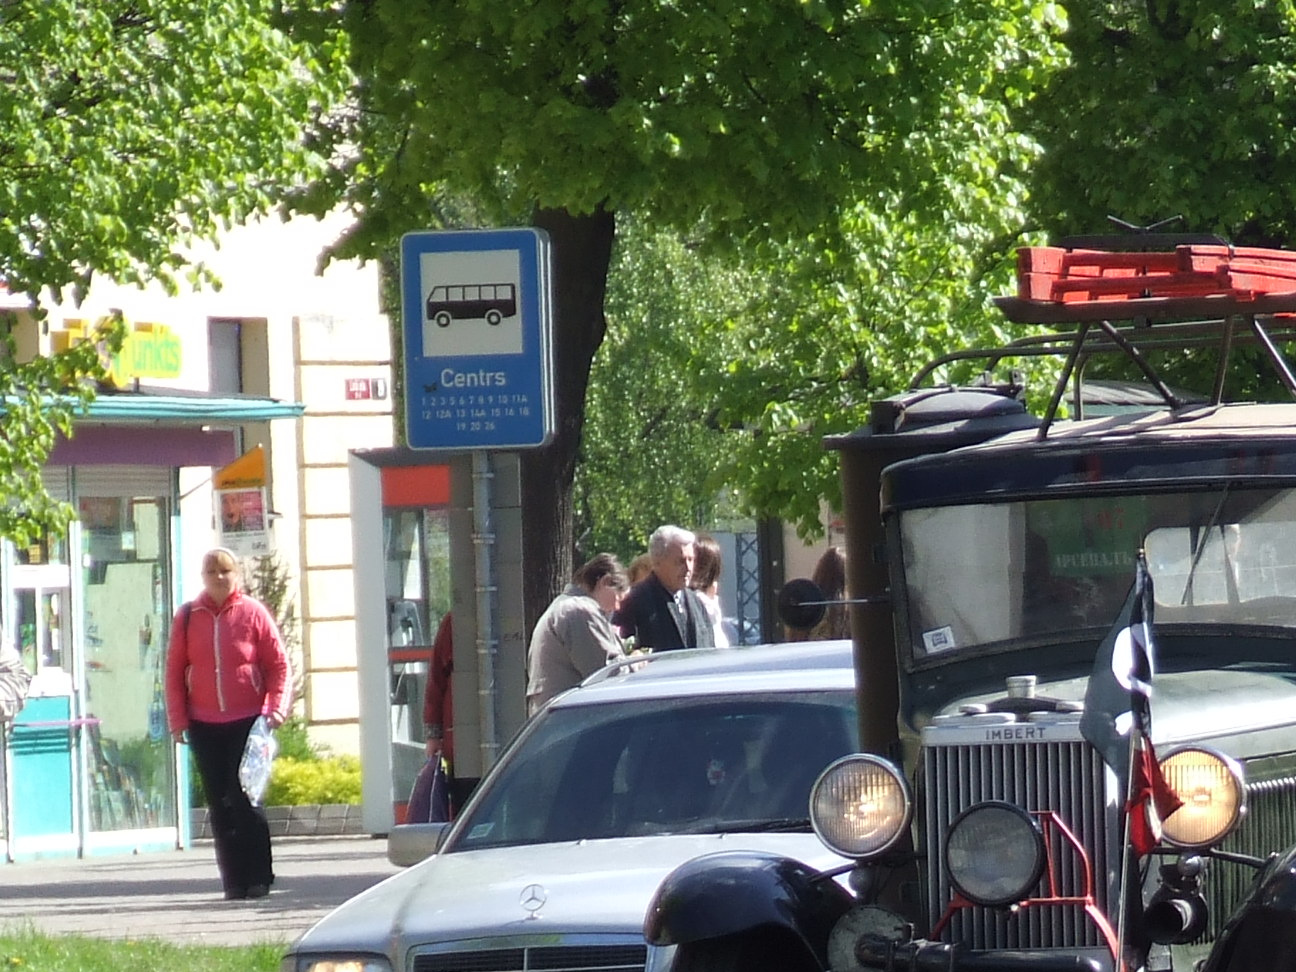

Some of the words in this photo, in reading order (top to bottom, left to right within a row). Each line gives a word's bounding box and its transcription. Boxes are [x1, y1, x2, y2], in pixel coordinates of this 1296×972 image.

[440, 368, 506, 388] Centrs
[422, 397, 426, 406] 1
[431, 397, 436, 406] 2
[440, 397, 446, 406] 3
[449, 396, 455, 406] 5
[459, 396, 465, 405] 6
[469, 396, 474, 405] 7
[478, 396, 484, 404] 8
[488, 395, 493, 404] 9
[498, 395, 508, 404] 10
[422, 410, 431, 419] 12
[456, 409, 466, 418] 13
[491, 408, 501, 417] 15
[505, 407, 514, 416] 16
[456, 422, 466, 431] 19
[470, 422, 480, 430] 20
[485, 421, 495, 430] 26
[986, 727, 1046, 740] IMBERT
